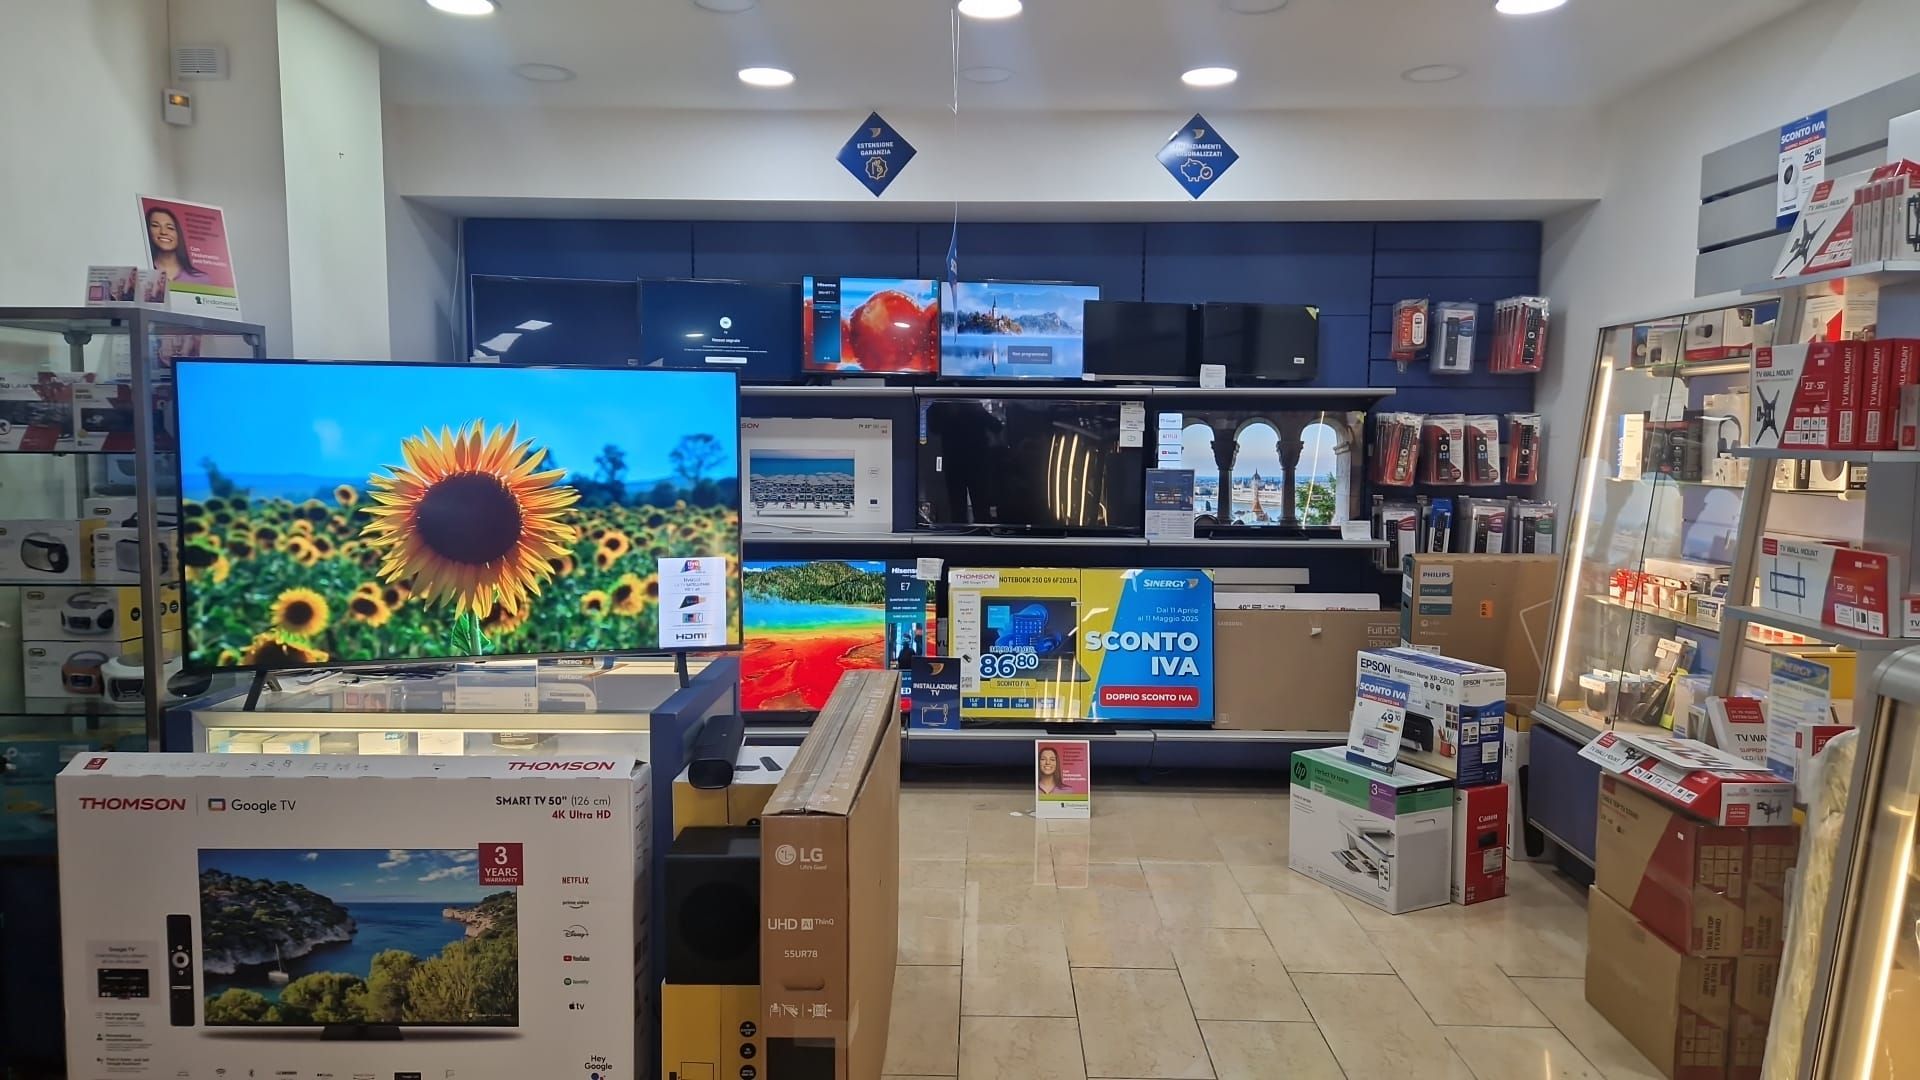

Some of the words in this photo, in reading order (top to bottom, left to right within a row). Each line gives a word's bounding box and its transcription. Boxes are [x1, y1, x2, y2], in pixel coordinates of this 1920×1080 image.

[1781, 127, 1811, 144] SCONTO
[1811, 120, 1825, 133] IVA
[857, 141, 894, 149] ESTENSIONE
[860, 148, 892, 156] GARANZIA
[1804, 151, 1815, 164] 26
[1844, 347, 1852, 374] MOUNT
[1872, 347, 1881, 374] MOUNT
[1900, 345, 1909, 373] MOUNT
[1763, 370, 1775, 378] WALL
[1775, 368, 1794, 377] MOUNT
[1842, 375, 1851, 396] WALL
[1870, 375, 1879, 396] WALL
[1841, 396, 1849, 406] TV
[1869, 396, 1877, 406] TV
[1786, 546, 1799, 554] WALL
[1800, 548, 1819, 557] MOUNT
[999, 576, 1031, 584] NOTEBOOK
[1143, 578, 1186, 588] SINERGY
[900, 582, 911, 591] E7
[1156, 606, 1169, 614] Dal
[1170, 606, 1176, 614] 11
[1177, 606, 1199, 615] Aprile
[1152, 615, 1181, 623] Maggio
[675, 632, 708, 640] HDMI
[1367, 626, 1383, 636] Full
[1383, 626, 1397, 636] HD
[1085, 630, 1200, 653] SCONTO
[1367, 639, 1392, 648] T5300
[557, 658, 584, 666] SINERGY
[979, 653, 1017, 679] 86
[1015, 653, 1039, 669] 80
[1151, 655, 1200, 677] IVA
[1360, 657, 1391, 674] EPSON
[1394, 666, 1416, 678] Expression
[1416, 672, 1429, 681] Home
[1429, 674, 1455, 686] XP-2200
[912, 682, 959, 690] INSTALLAZIONE
[1463, 679, 1481, 687] EPSON
[930, 689, 941, 697] TV
[1359, 681, 1392, 696] SCONTO
[1392, 689, 1407, 701] IVA
[1105, 692, 1140, 702] DOPPIO
[1140, 692, 1177, 702] SCONTO
[1178, 692, 1193, 702] IVA
[1380, 711, 1395, 723] 49
[1735, 733, 1748, 742] TV
[1749, 733, 1768, 742] WA
[508, 761, 616, 771] THOMSON
[1371, 783, 1378, 795] 3
[79, 797, 186, 811] THOMSON
[231, 799, 277, 814] Google
[279, 799, 297, 811] TV
[495, 796, 531, 806] SMART
[534, 796, 547, 806] TV
[548, 796, 568, 806] 50"
[570, 796, 590, 807] (126
[593, 796, 612, 807] cm)
[551, 810, 566, 819] 4K
[569, 810, 593, 819] Ultra
[596, 810, 612, 819] HD
[1478, 813, 1498, 823] Canon
[494, 846, 508, 865] 3
[799, 847, 823, 863] LG
[484, 867, 518, 877] YEARS
[561, 876, 590, 885] NETFLIX
[767, 918, 798, 930] UHD
[801, 918, 814, 931] AI
[814, 918, 835, 926] ThinQ
[784, 950, 818, 958] 55UR78
[576, 1002, 585, 1010] tv
[590, 1055, 606, 1064] Hey
[584, 1062, 613, 1072] Google
